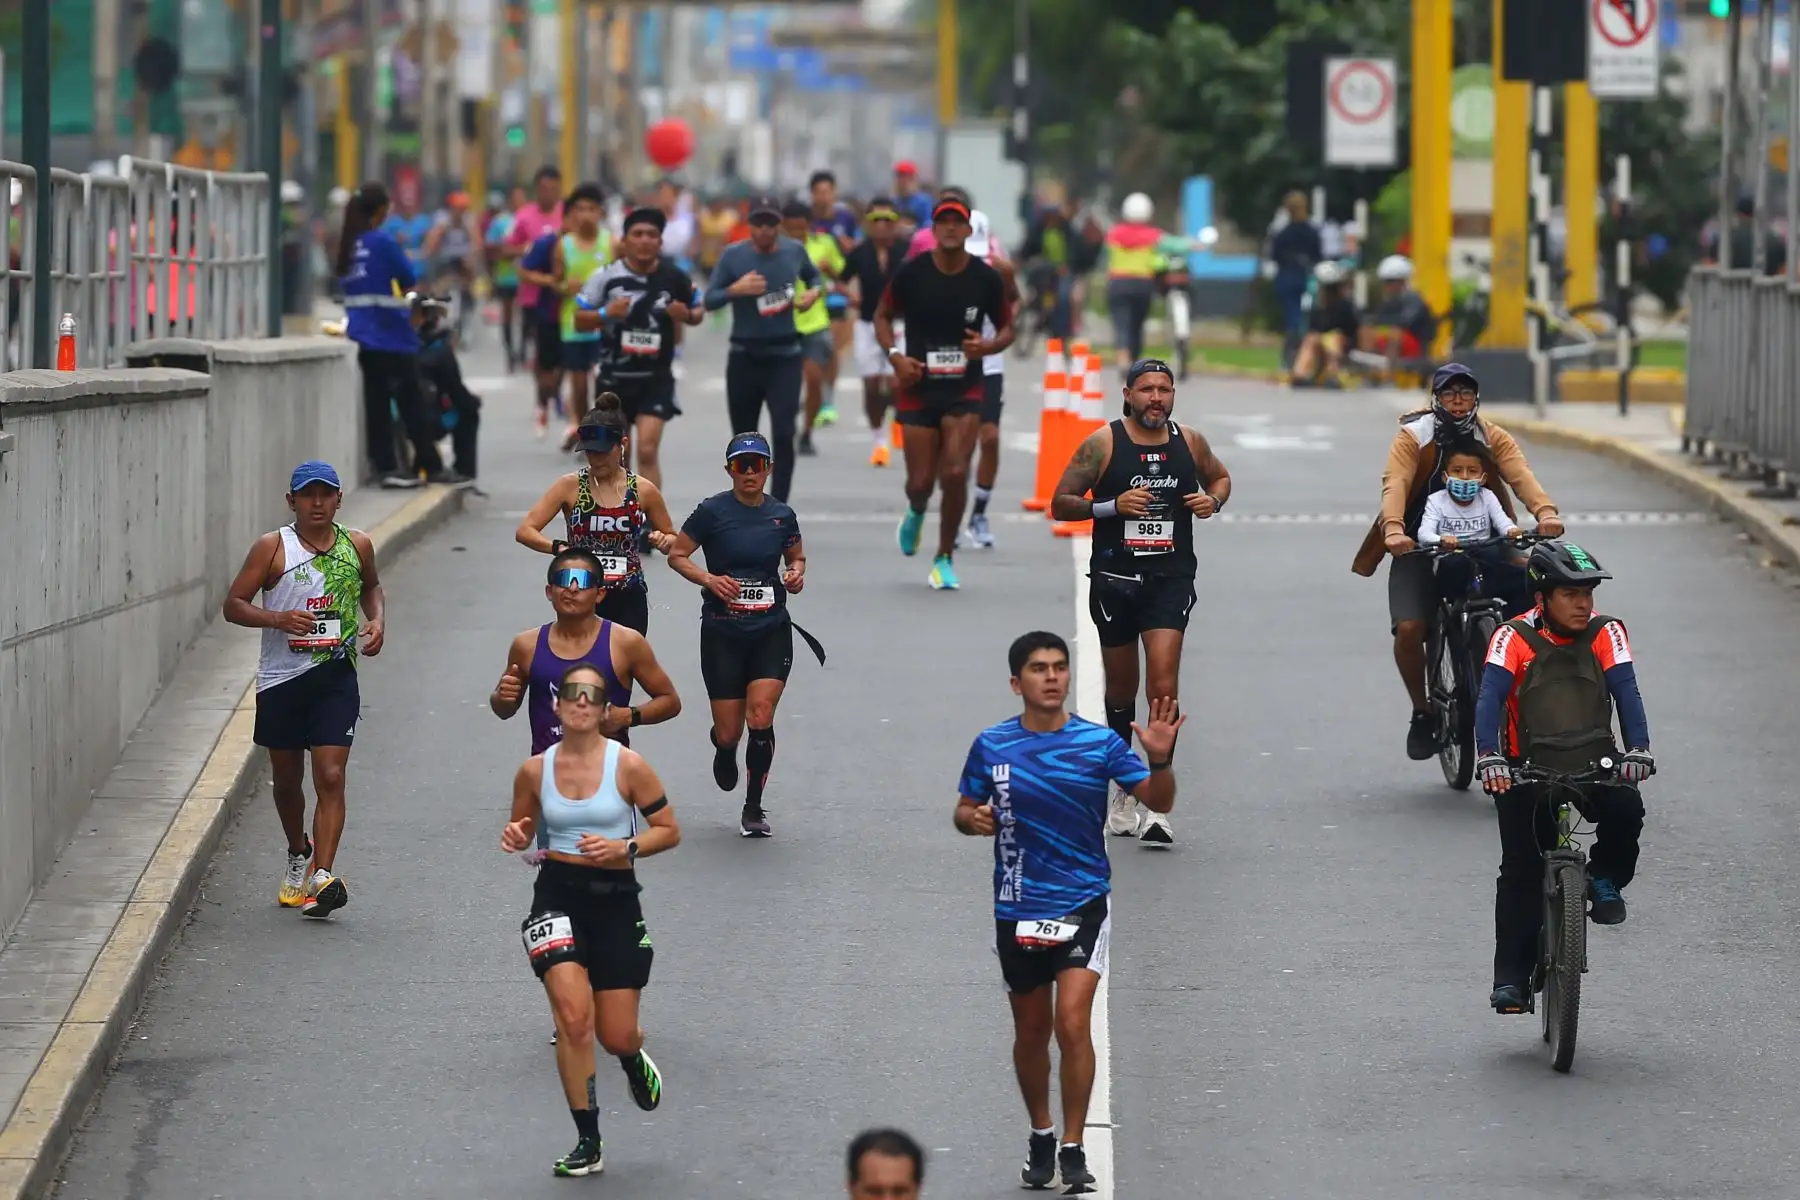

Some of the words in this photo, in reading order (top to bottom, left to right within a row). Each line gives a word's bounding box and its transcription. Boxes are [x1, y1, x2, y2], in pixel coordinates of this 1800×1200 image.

[1140, 452, 1167, 461] PERÚ
[1130, 475, 1178, 491] Pescados
[590, 516, 630, 531] IRC
[1138, 523, 1162, 535] 983
[530, 922, 553, 942] 647
[1035, 922, 1060, 936] 761
